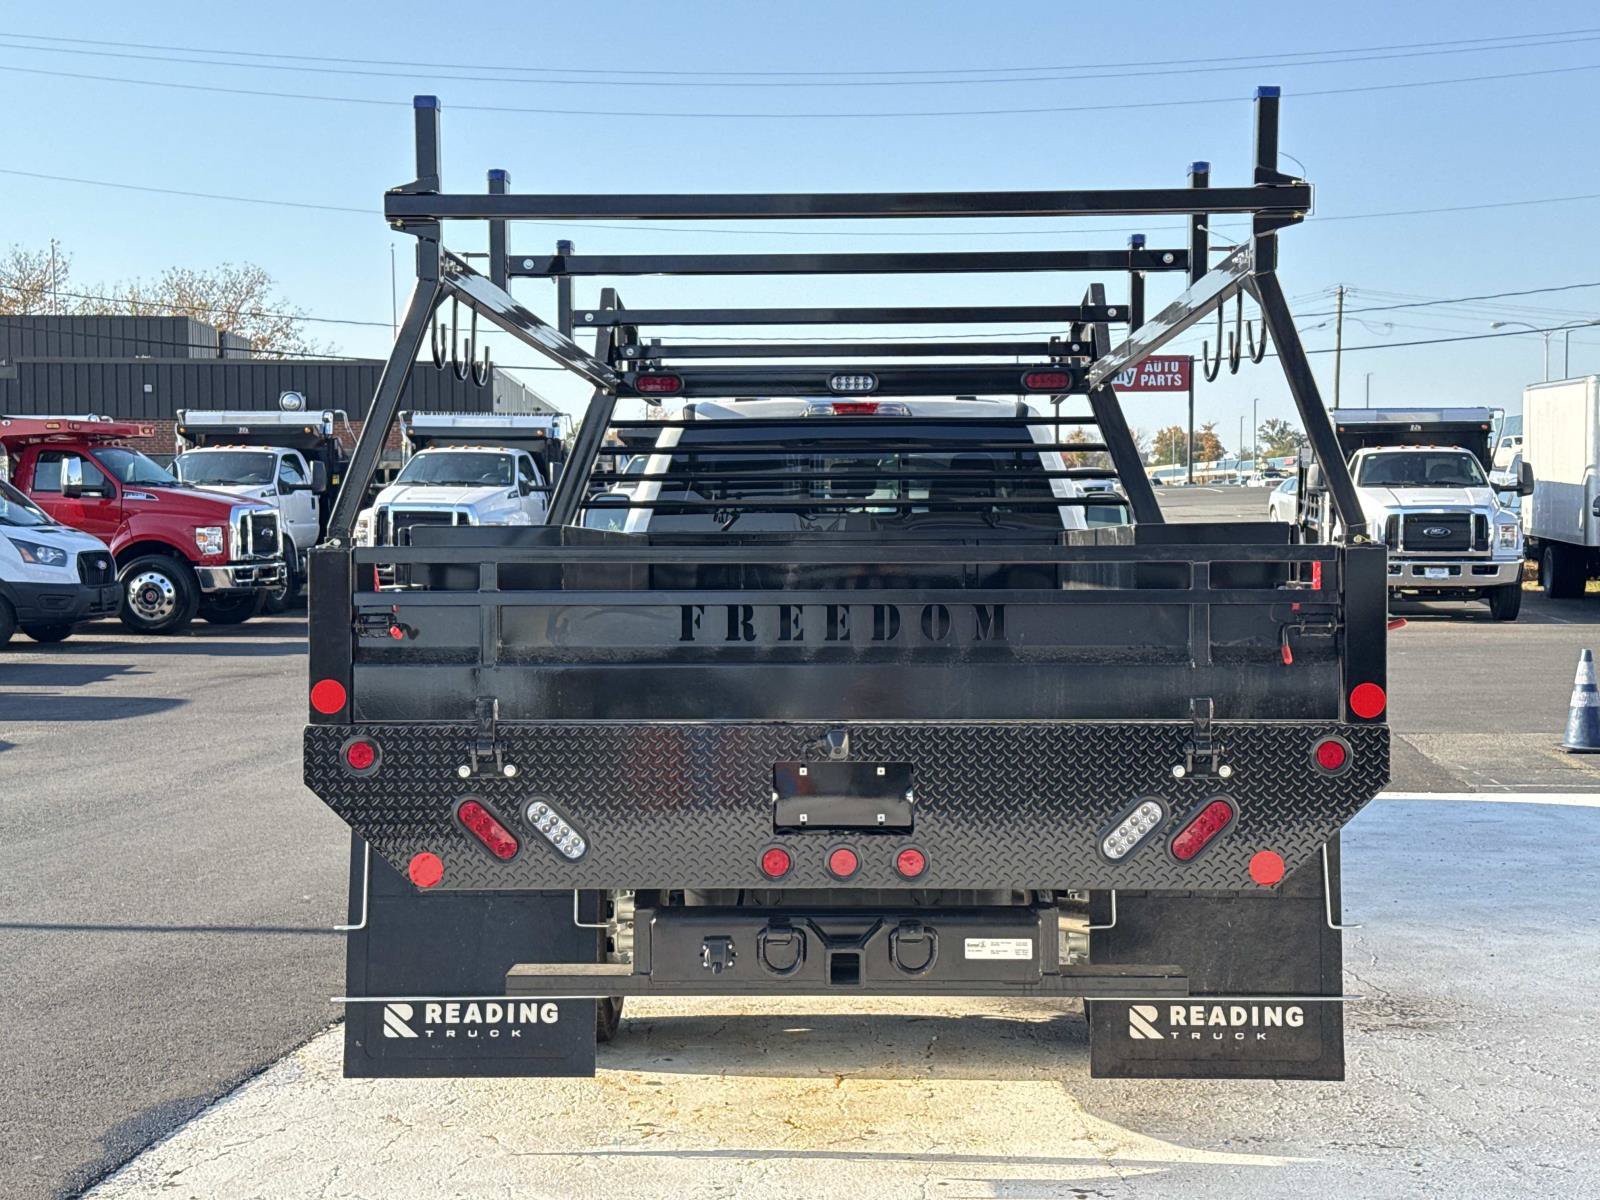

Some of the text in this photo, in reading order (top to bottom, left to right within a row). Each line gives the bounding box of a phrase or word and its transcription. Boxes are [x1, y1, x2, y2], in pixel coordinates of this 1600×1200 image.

[1144, 360, 1179, 372] AUTO
[1141, 374, 1182, 386] PARTS
[679, 604, 1008, 642] FREEDOM
[425, 1002, 559, 1024] READING
[1170, 1005, 1304, 1027] READING
[425, 1030, 522, 1038] TRUCK
[1171, 1032, 1267, 1040] TRUCK
